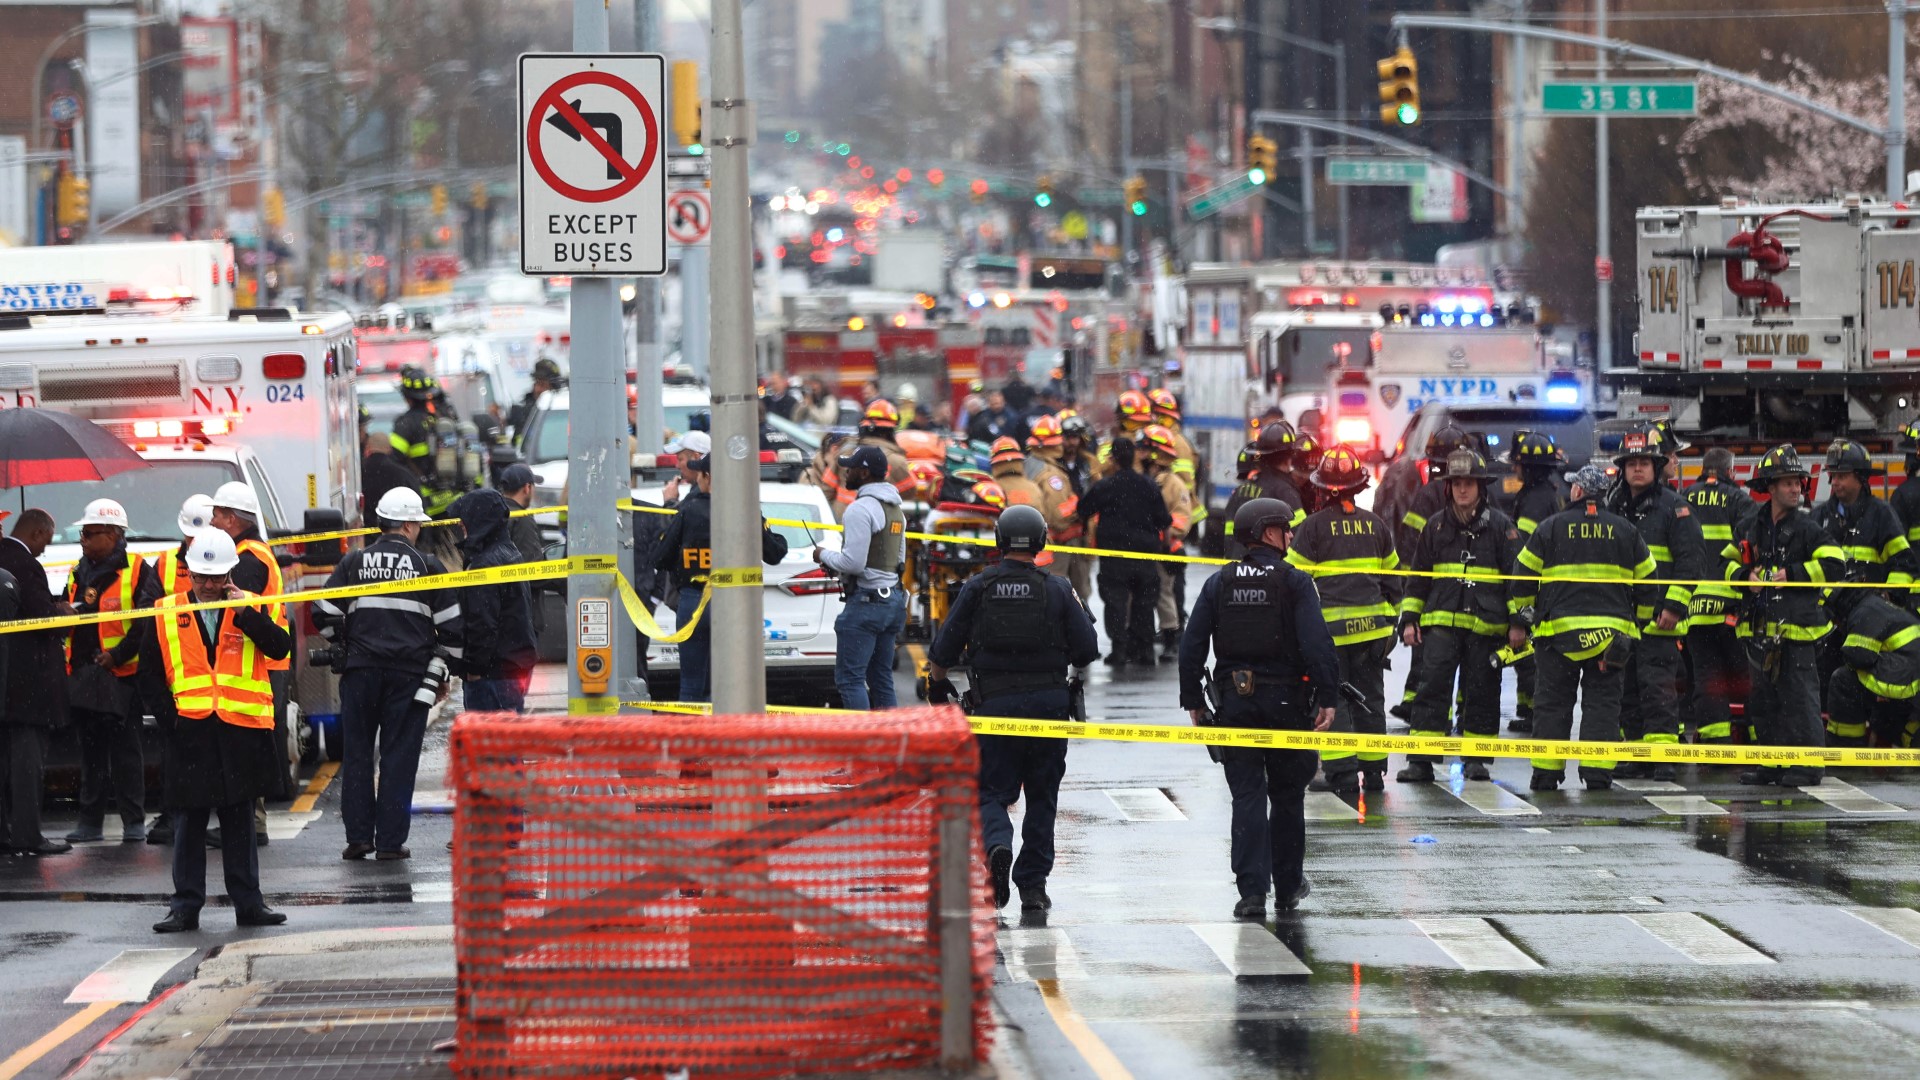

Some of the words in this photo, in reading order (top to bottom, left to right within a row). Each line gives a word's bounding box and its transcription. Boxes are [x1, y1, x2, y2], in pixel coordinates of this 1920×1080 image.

[1580, 86, 1615, 110] 35
[1628, 86, 1658, 110] St
[548, 215, 638, 234] EXCEPT
[554, 243, 632, 262] BUSES
[3, 285, 82, 298] NYPD
[1648, 266, 1678, 313] 114
[1877, 260, 1916, 309] 114
[1736, 334, 1783, 355] TALLY
[1787, 334, 1810, 355] HO
[267, 384, 304, 403] 024
[1420, 380, 1496, 394] NYPD
[192, 386, 251, 415] N.Y.
[363, 552, 414, 570] MTA
[683, 548, 711, 568] FB
[358, 568, 391, 580] PHOTO
[394, 570, 420, 580] UNIT
[997, 584, 1030, 596] NYPD
[1234, 589, 1266, 602] NYPD
[1579, 628, 1612, 648] SMITH
